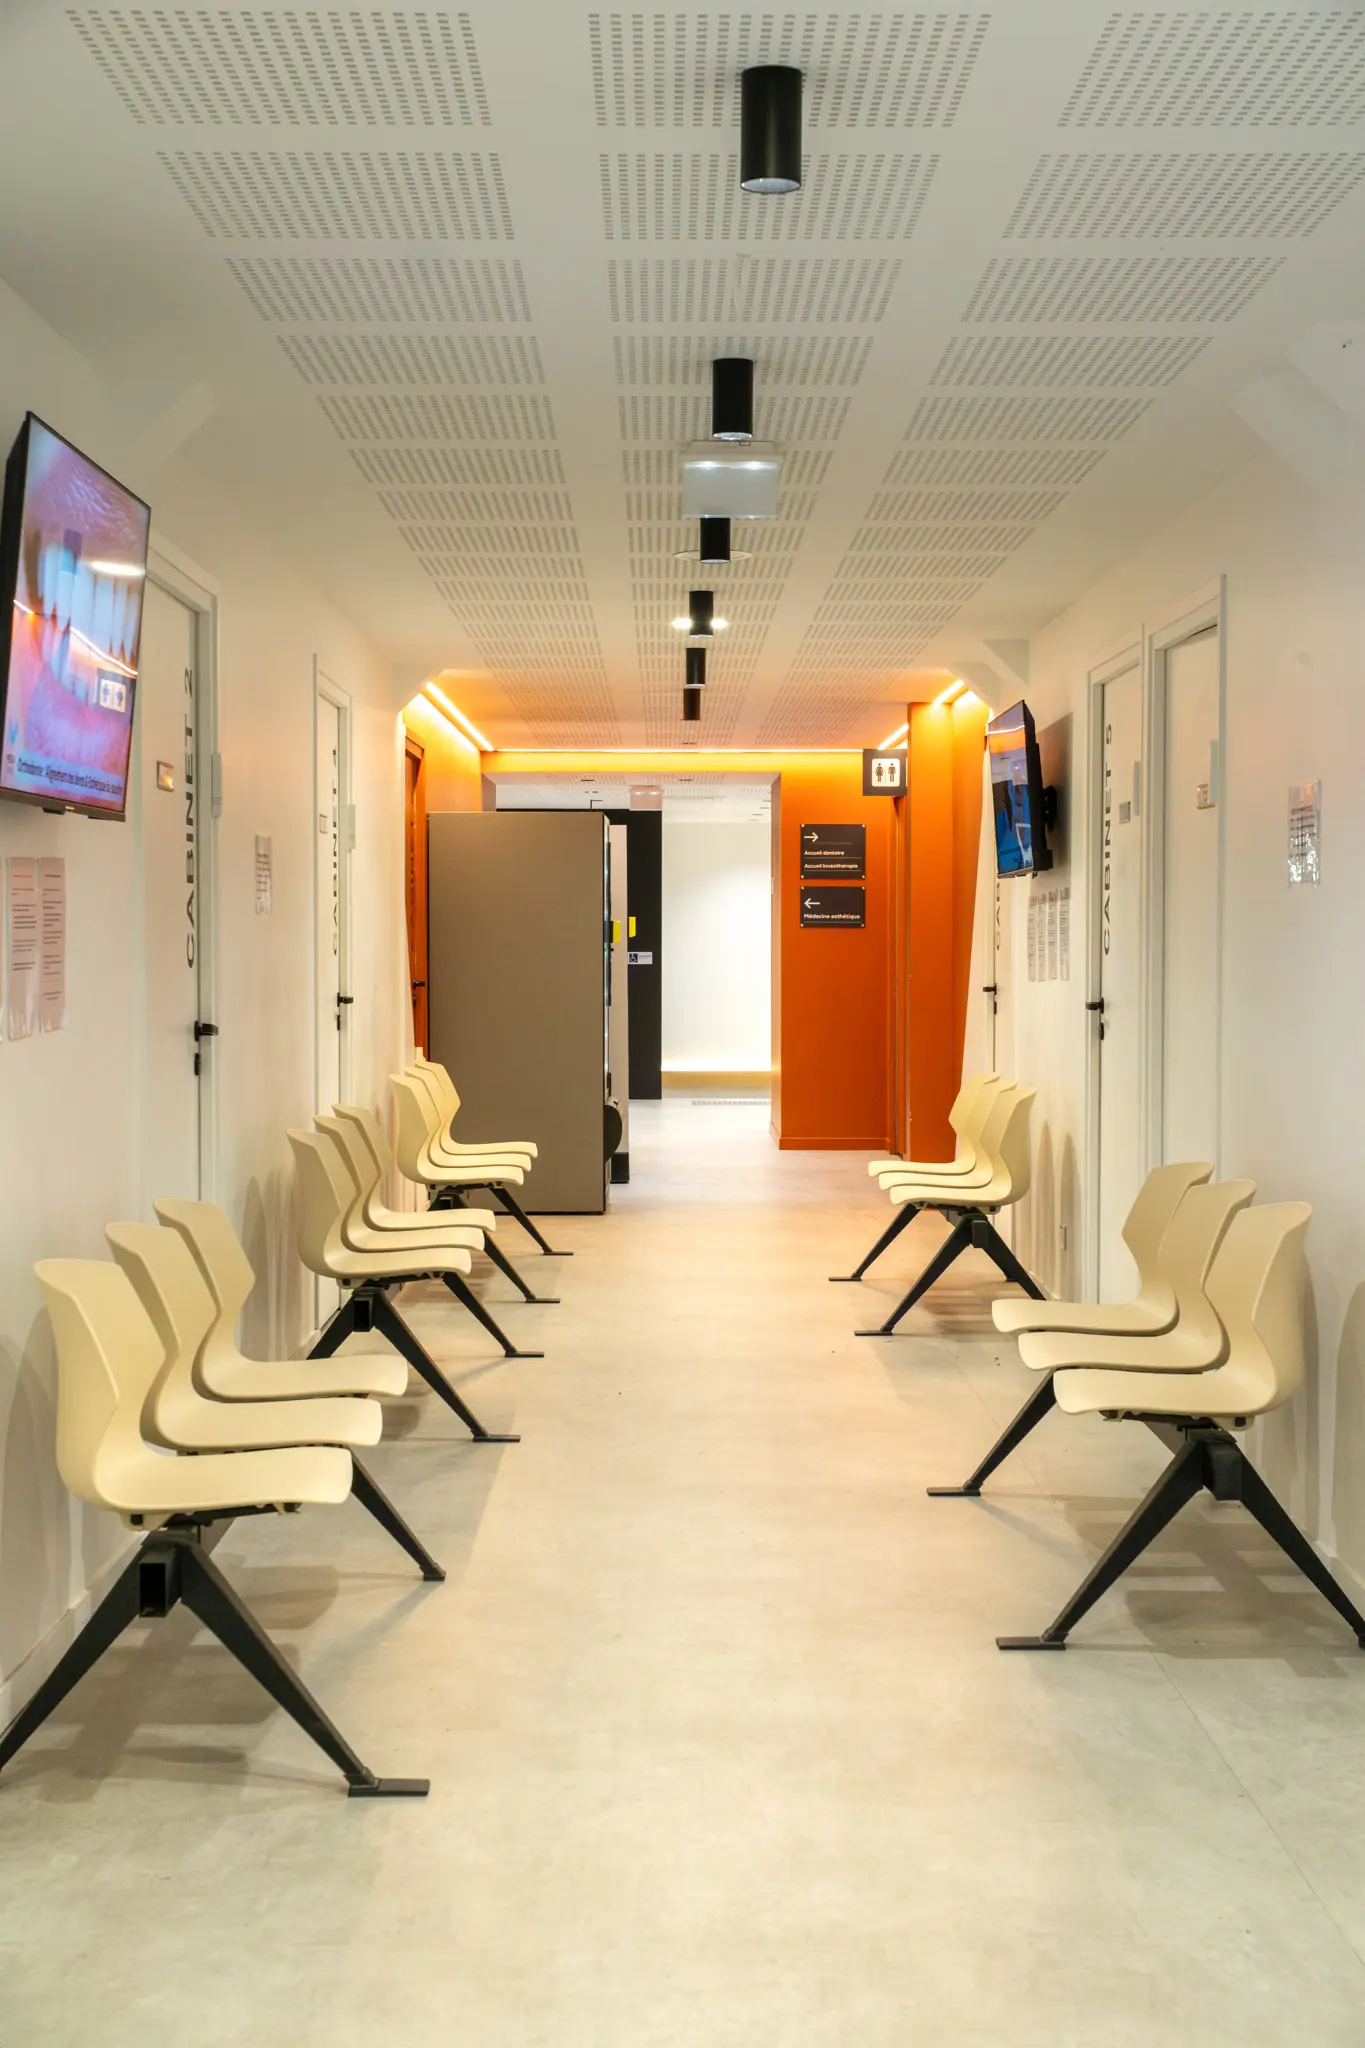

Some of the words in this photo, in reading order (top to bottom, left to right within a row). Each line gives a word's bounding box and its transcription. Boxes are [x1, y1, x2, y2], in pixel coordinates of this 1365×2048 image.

[185, 668, 193, 697] 2
[1105, 724, 1112, 745] 5
[185, 714, 194, 968] CABINET
